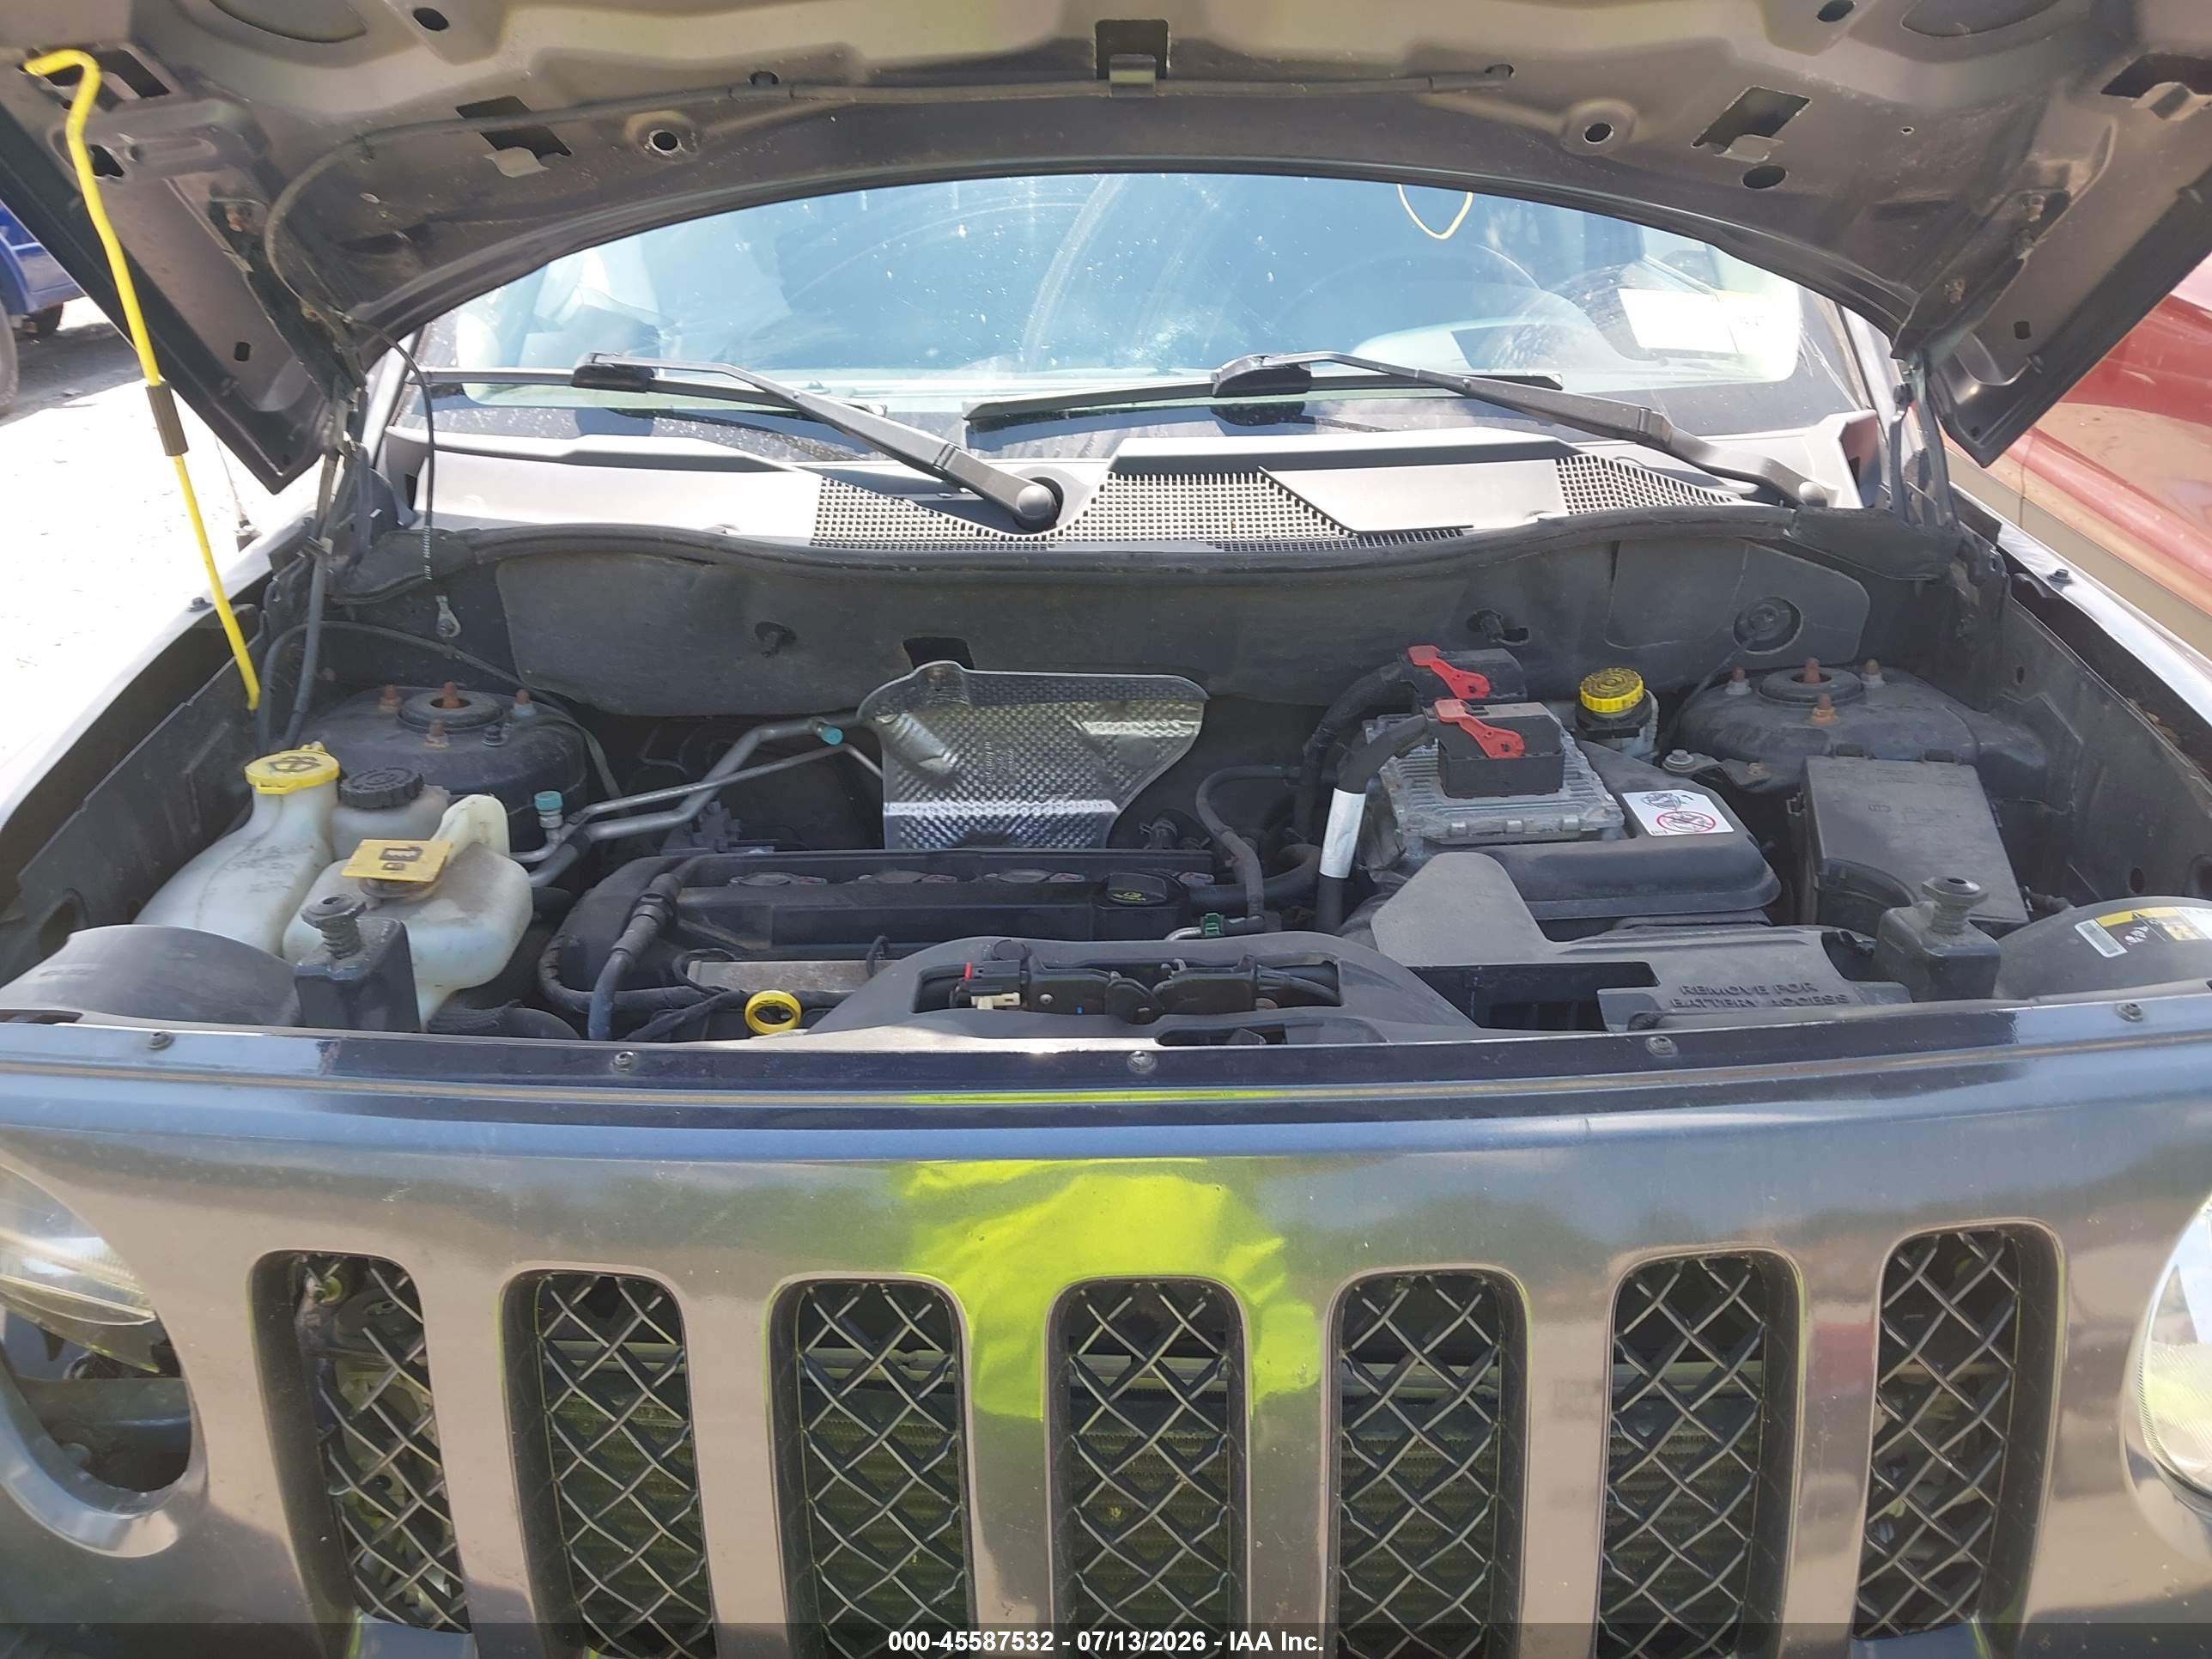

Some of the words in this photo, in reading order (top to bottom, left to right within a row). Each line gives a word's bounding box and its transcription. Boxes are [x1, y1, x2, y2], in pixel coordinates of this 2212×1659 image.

[1680, 985, 1769, 996] REMOVE
[1772, 982, 1819, 994] FOR
[1670, 998, 1759, 1008] BATTERY
[1771, 994, 1850, 1007] ACCESS
